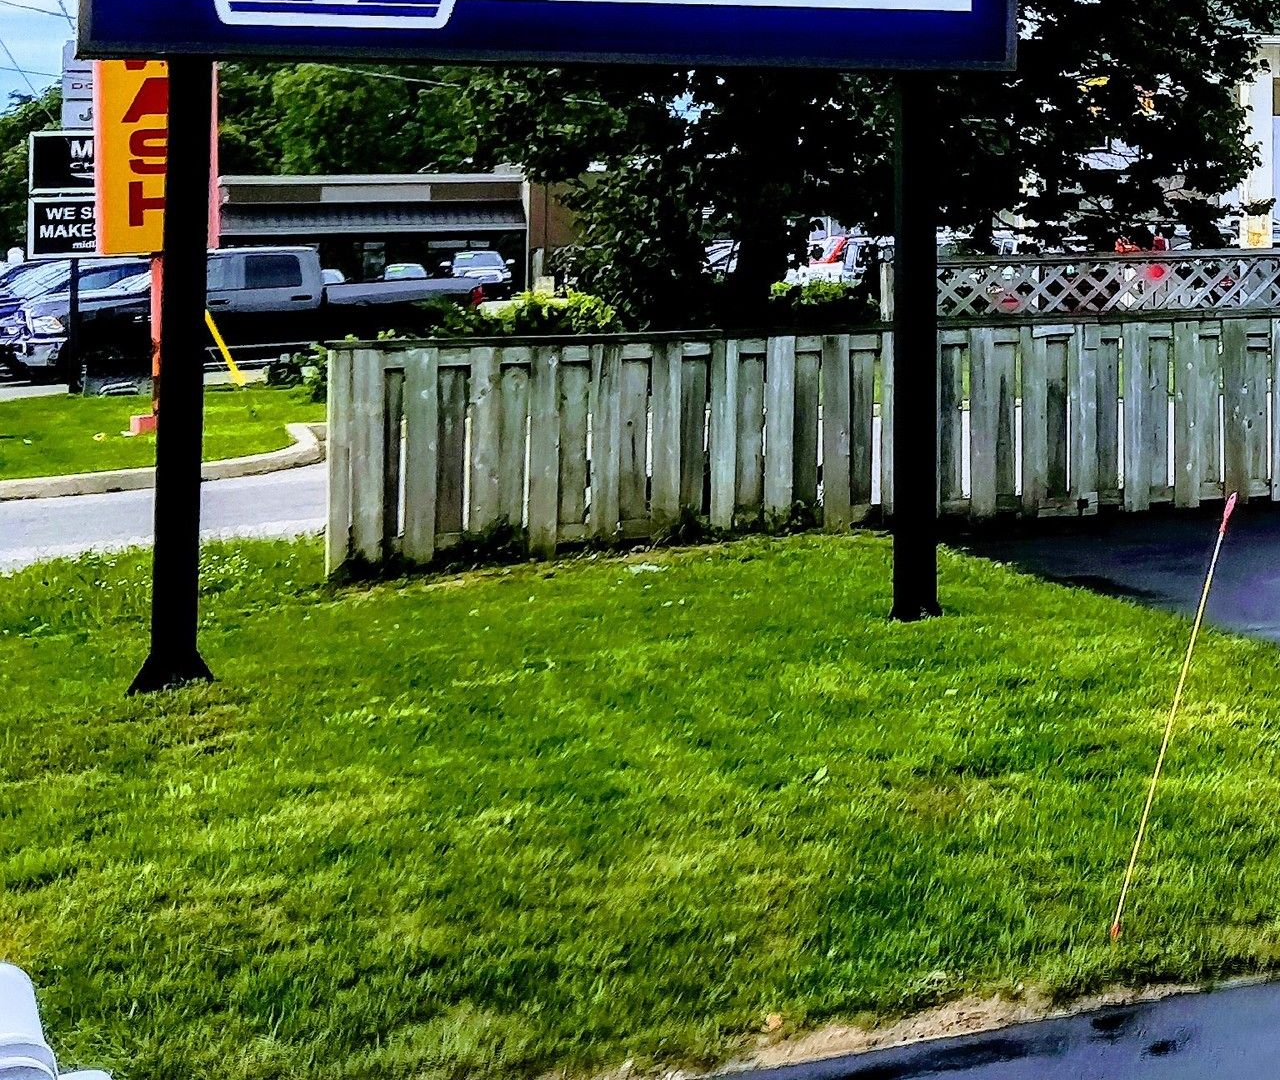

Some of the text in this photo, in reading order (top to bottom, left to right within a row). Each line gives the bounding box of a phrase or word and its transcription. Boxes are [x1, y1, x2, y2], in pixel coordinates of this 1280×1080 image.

[121, 60, 169, 227] ASH
[45, 207, 76, 220] WE
[39, 223, 97, 239] MAKE
